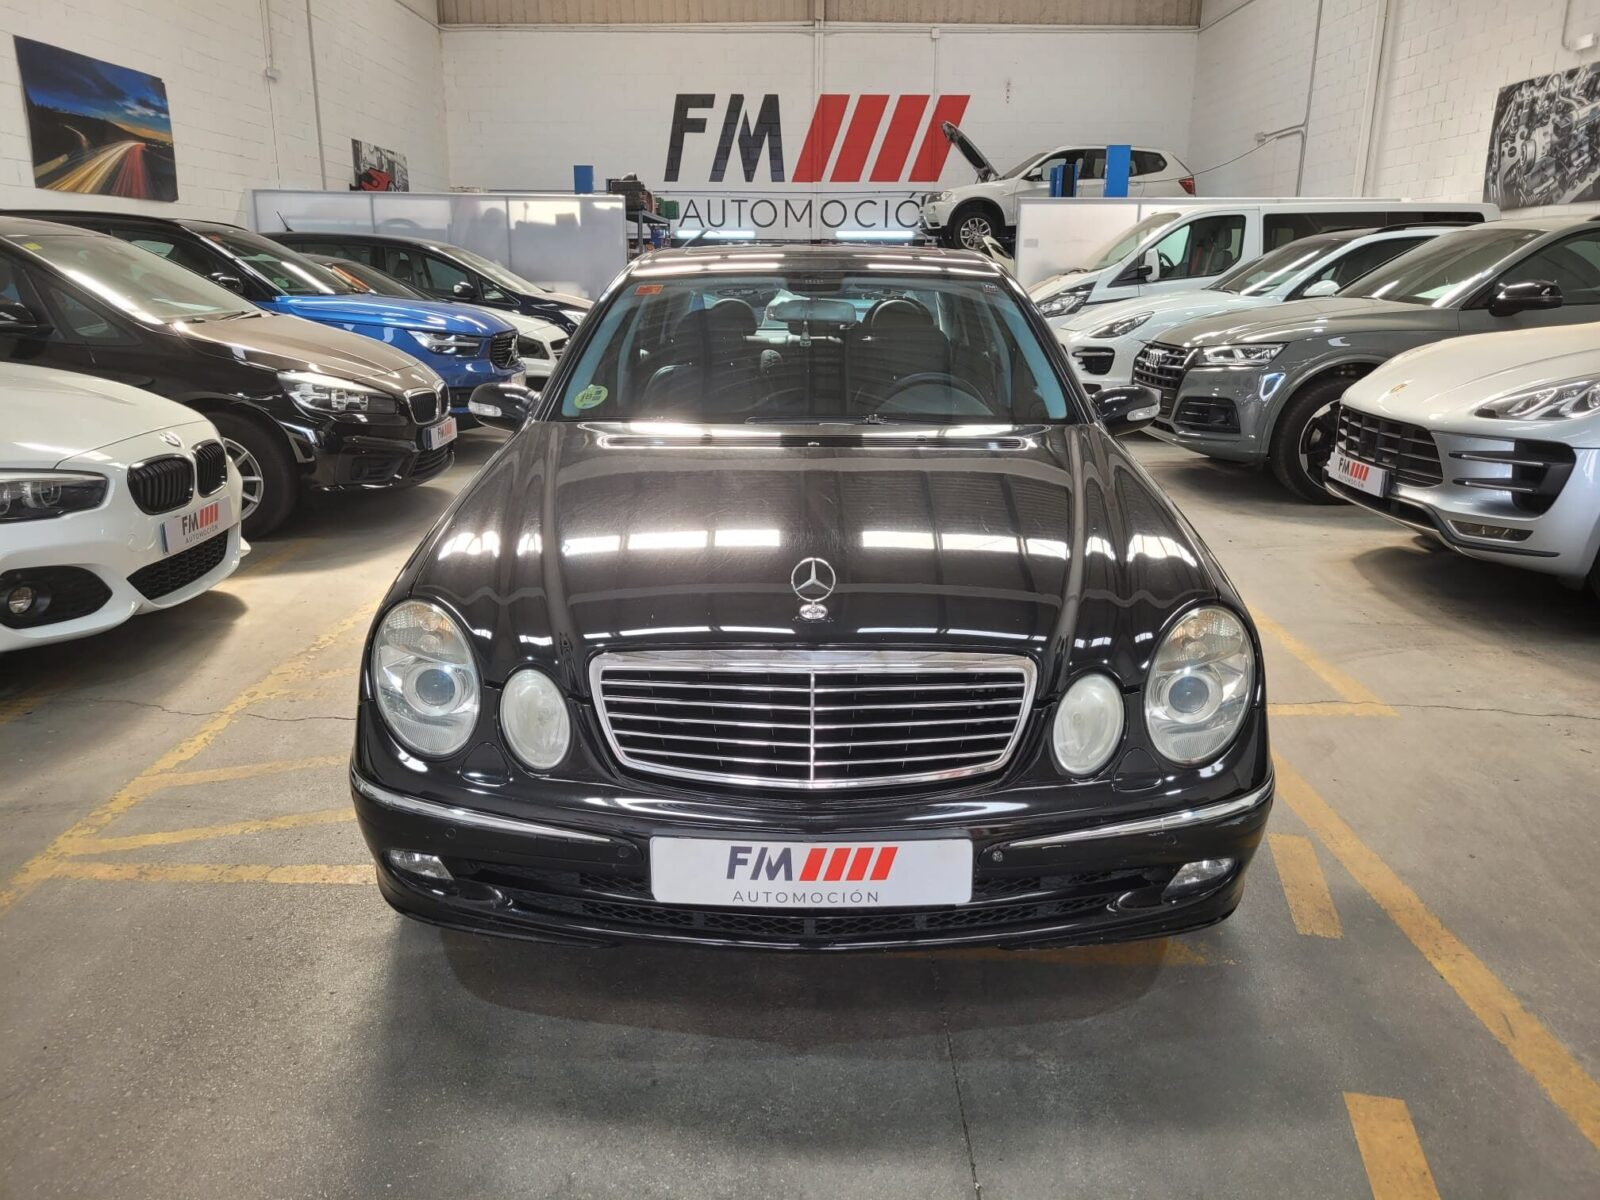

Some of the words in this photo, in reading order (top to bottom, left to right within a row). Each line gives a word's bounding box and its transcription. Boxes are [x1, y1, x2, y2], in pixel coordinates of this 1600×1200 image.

[664, 94, 785, 182] FM
[679, 192, 921, 228] AUTOMOCIÓ
[182, 511, 199, 536] FM
[726, 845, 793, 881] FM
[732, 888, 879, 904] AUTOMOCIÓN
